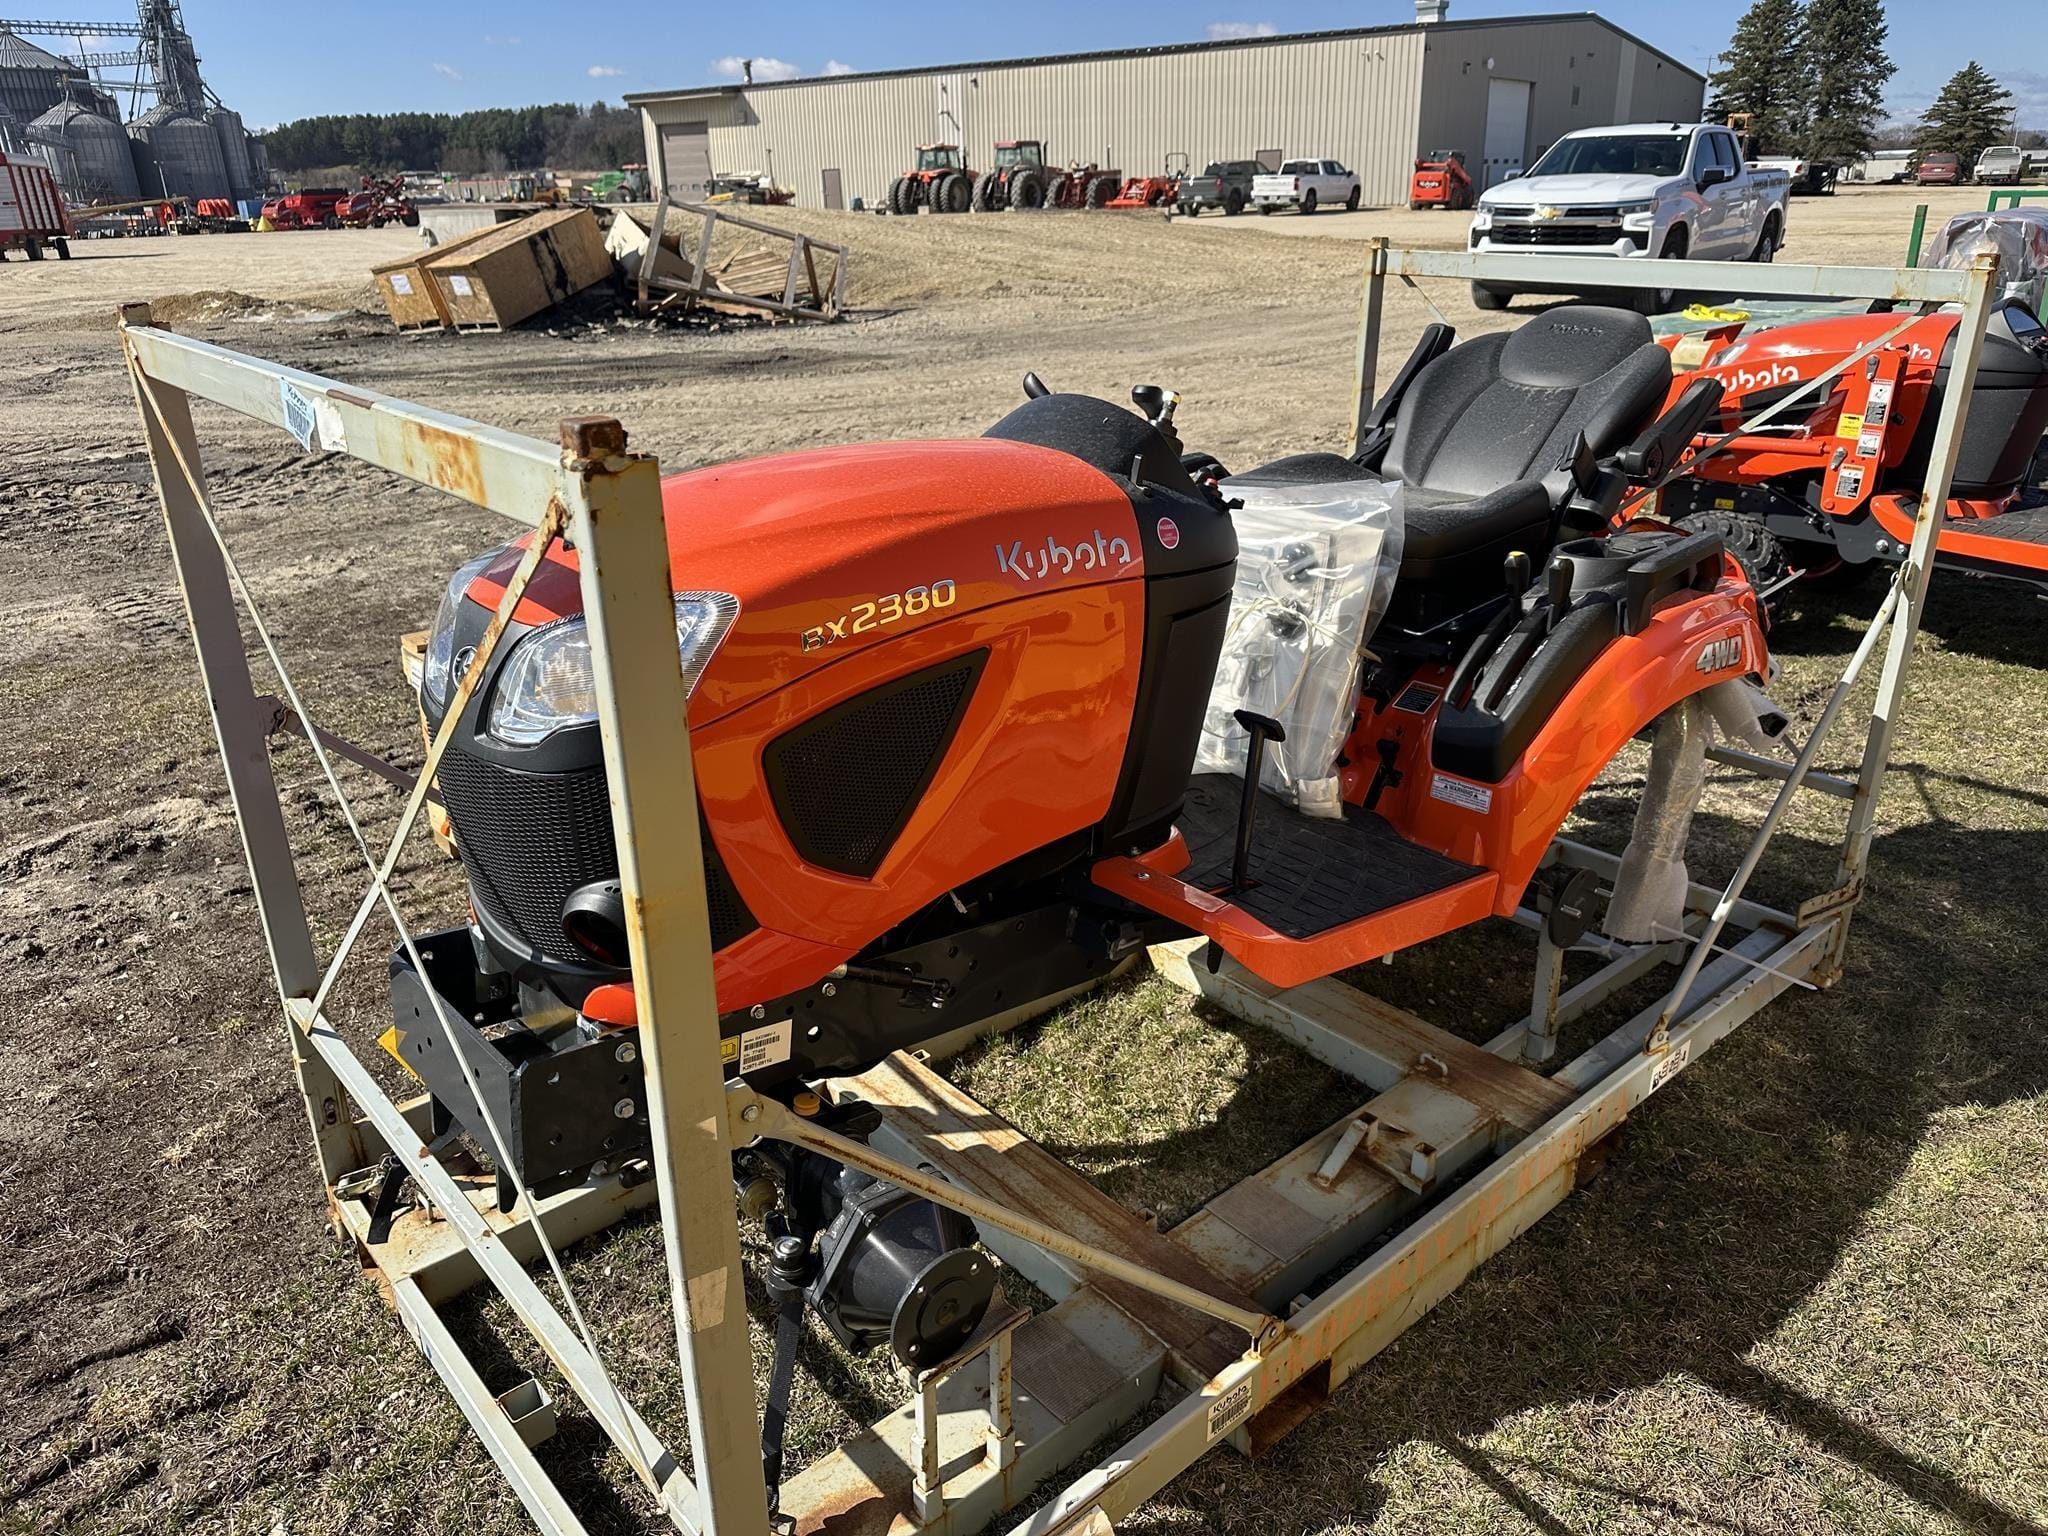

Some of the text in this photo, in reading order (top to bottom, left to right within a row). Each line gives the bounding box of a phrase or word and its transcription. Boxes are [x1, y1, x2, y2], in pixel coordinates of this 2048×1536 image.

[994, 529, 1130, 582] Kubota
[801, 579, 957, 654] BX2380
[1696, 634, 1742, 675] 4WD
[1213, 1384, 1249, 1414] Kubota
